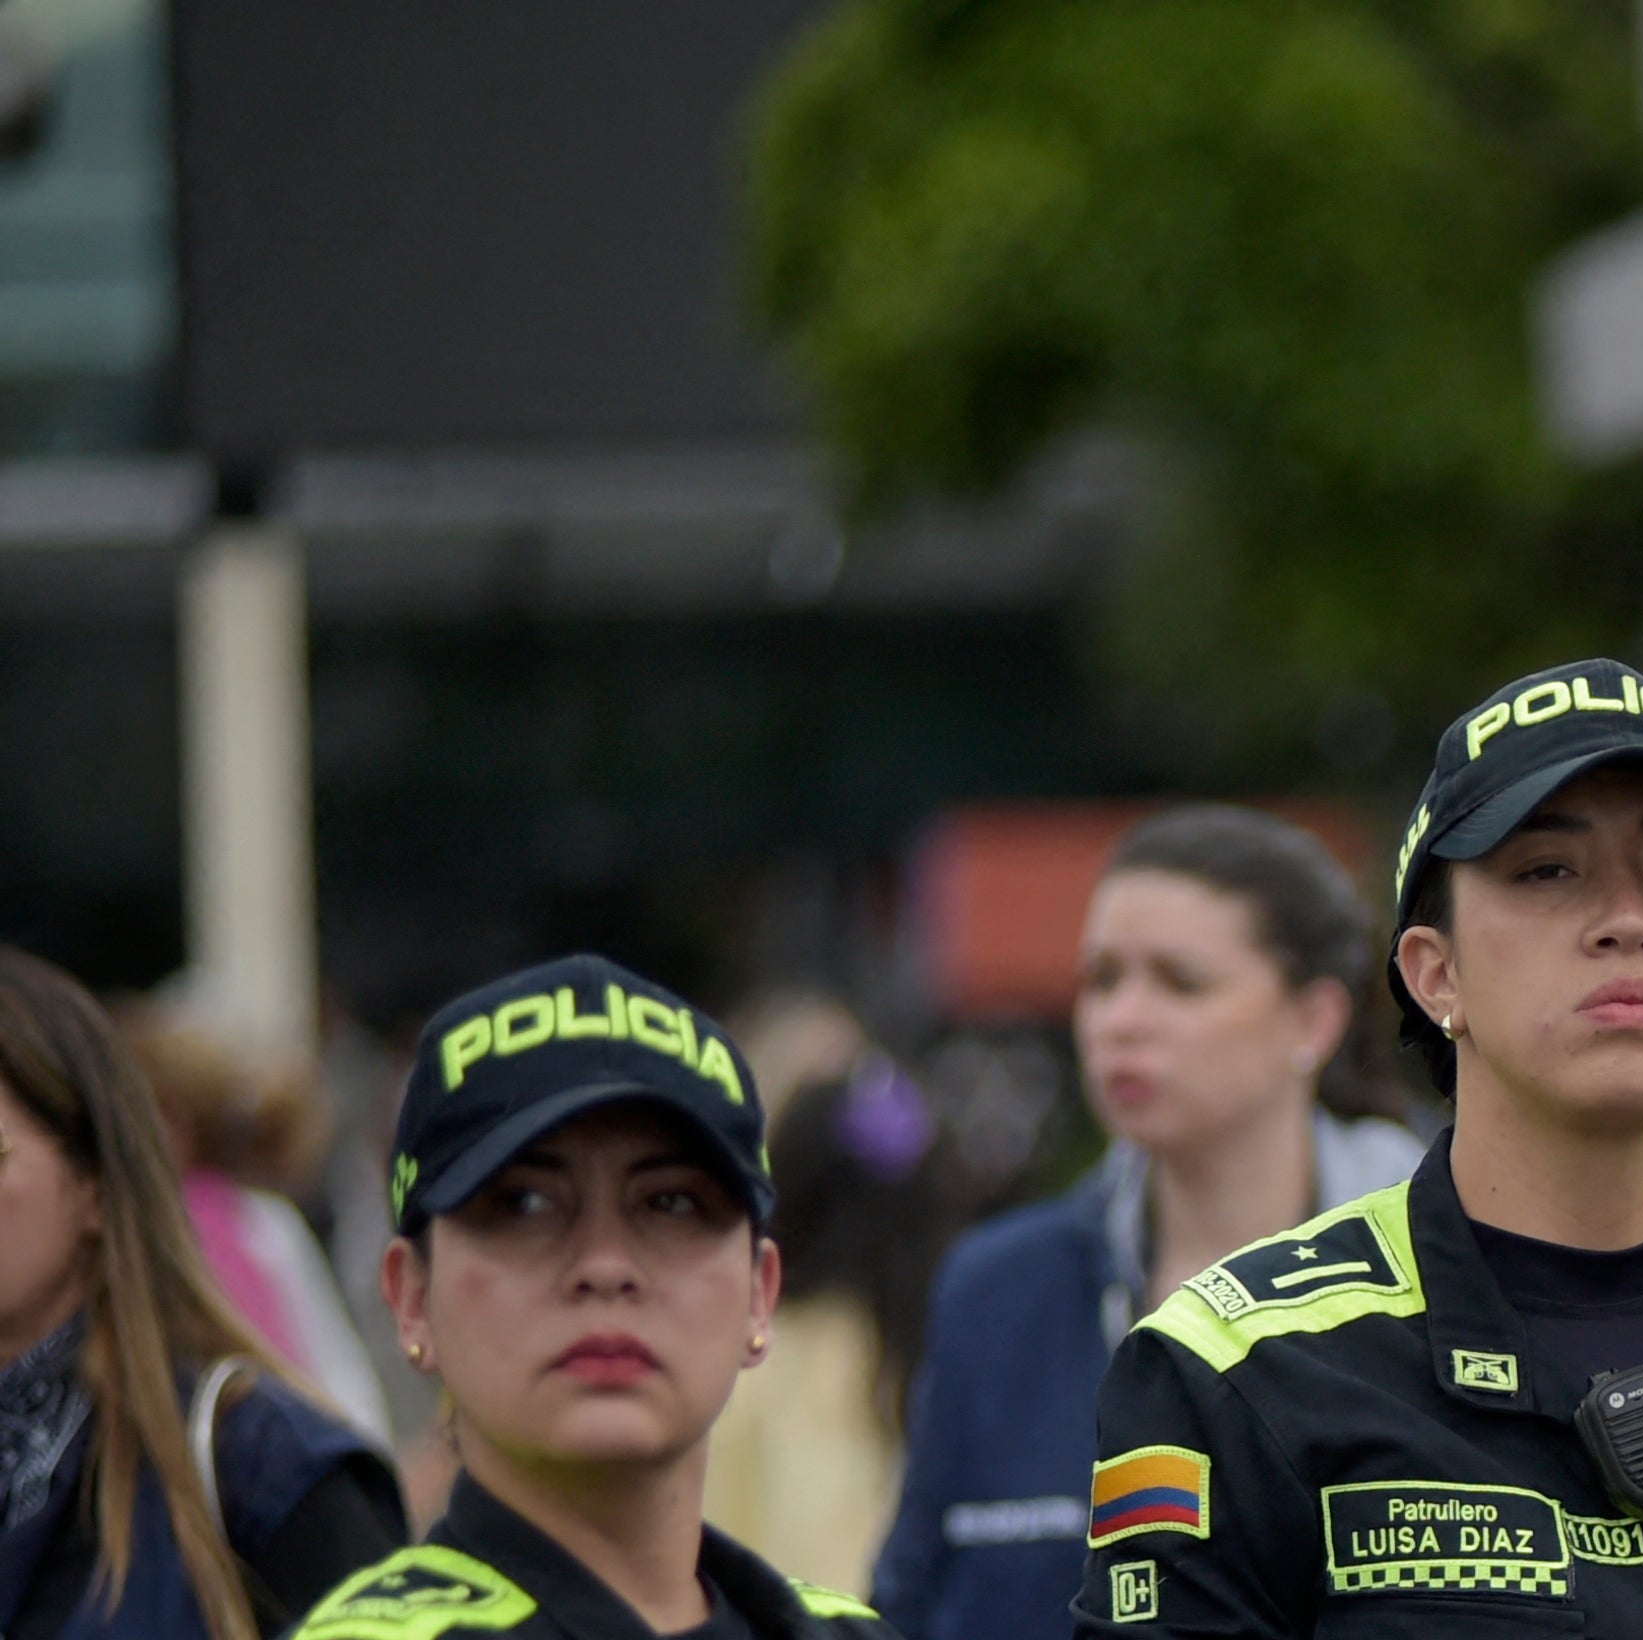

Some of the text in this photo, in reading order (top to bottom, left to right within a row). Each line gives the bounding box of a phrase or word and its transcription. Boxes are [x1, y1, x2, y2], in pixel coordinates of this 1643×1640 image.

[1388, 1498, 1498, 1523] Patrullero
[1352, 1526, 1534, 1558] LUISA DIAZ
